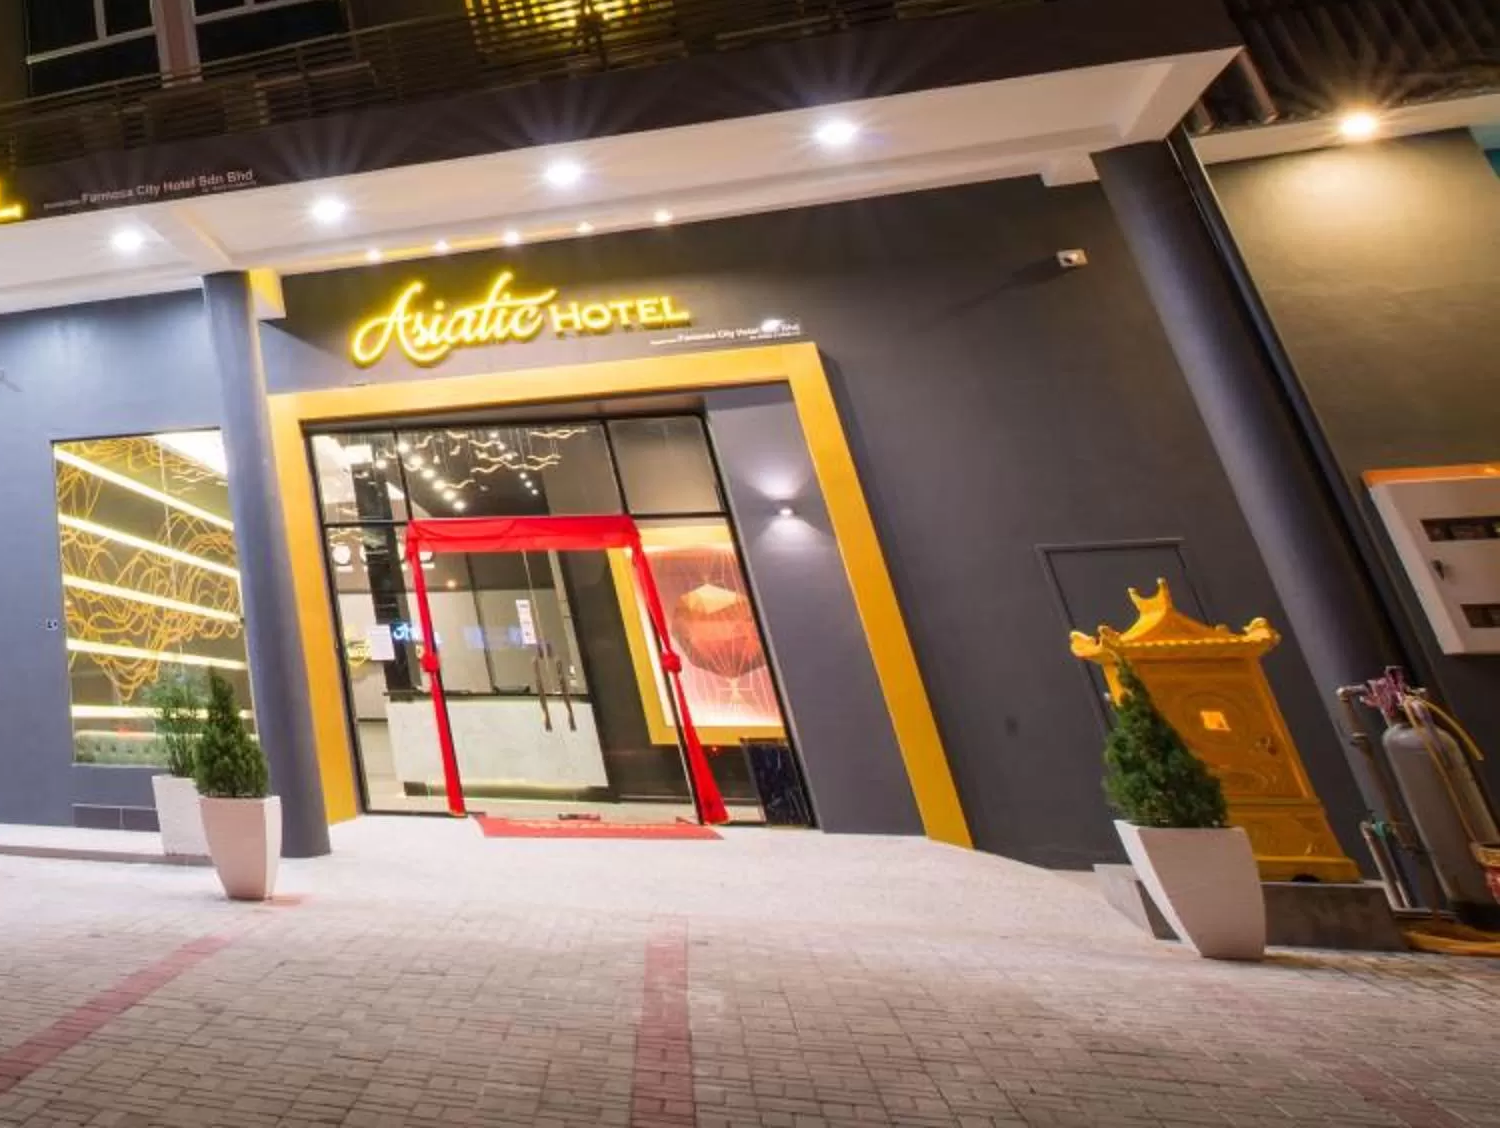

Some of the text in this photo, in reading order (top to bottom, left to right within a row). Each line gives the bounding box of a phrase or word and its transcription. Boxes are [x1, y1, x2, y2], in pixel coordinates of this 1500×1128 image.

[136, 184, 161, 198] City
[163, 180, 196, 193] Hotel
[199, 175, 224, 187] Sdn
[227, 169, 253, 183] Bhd
[350, 271, 690, 367] Asiatic HOTEL
